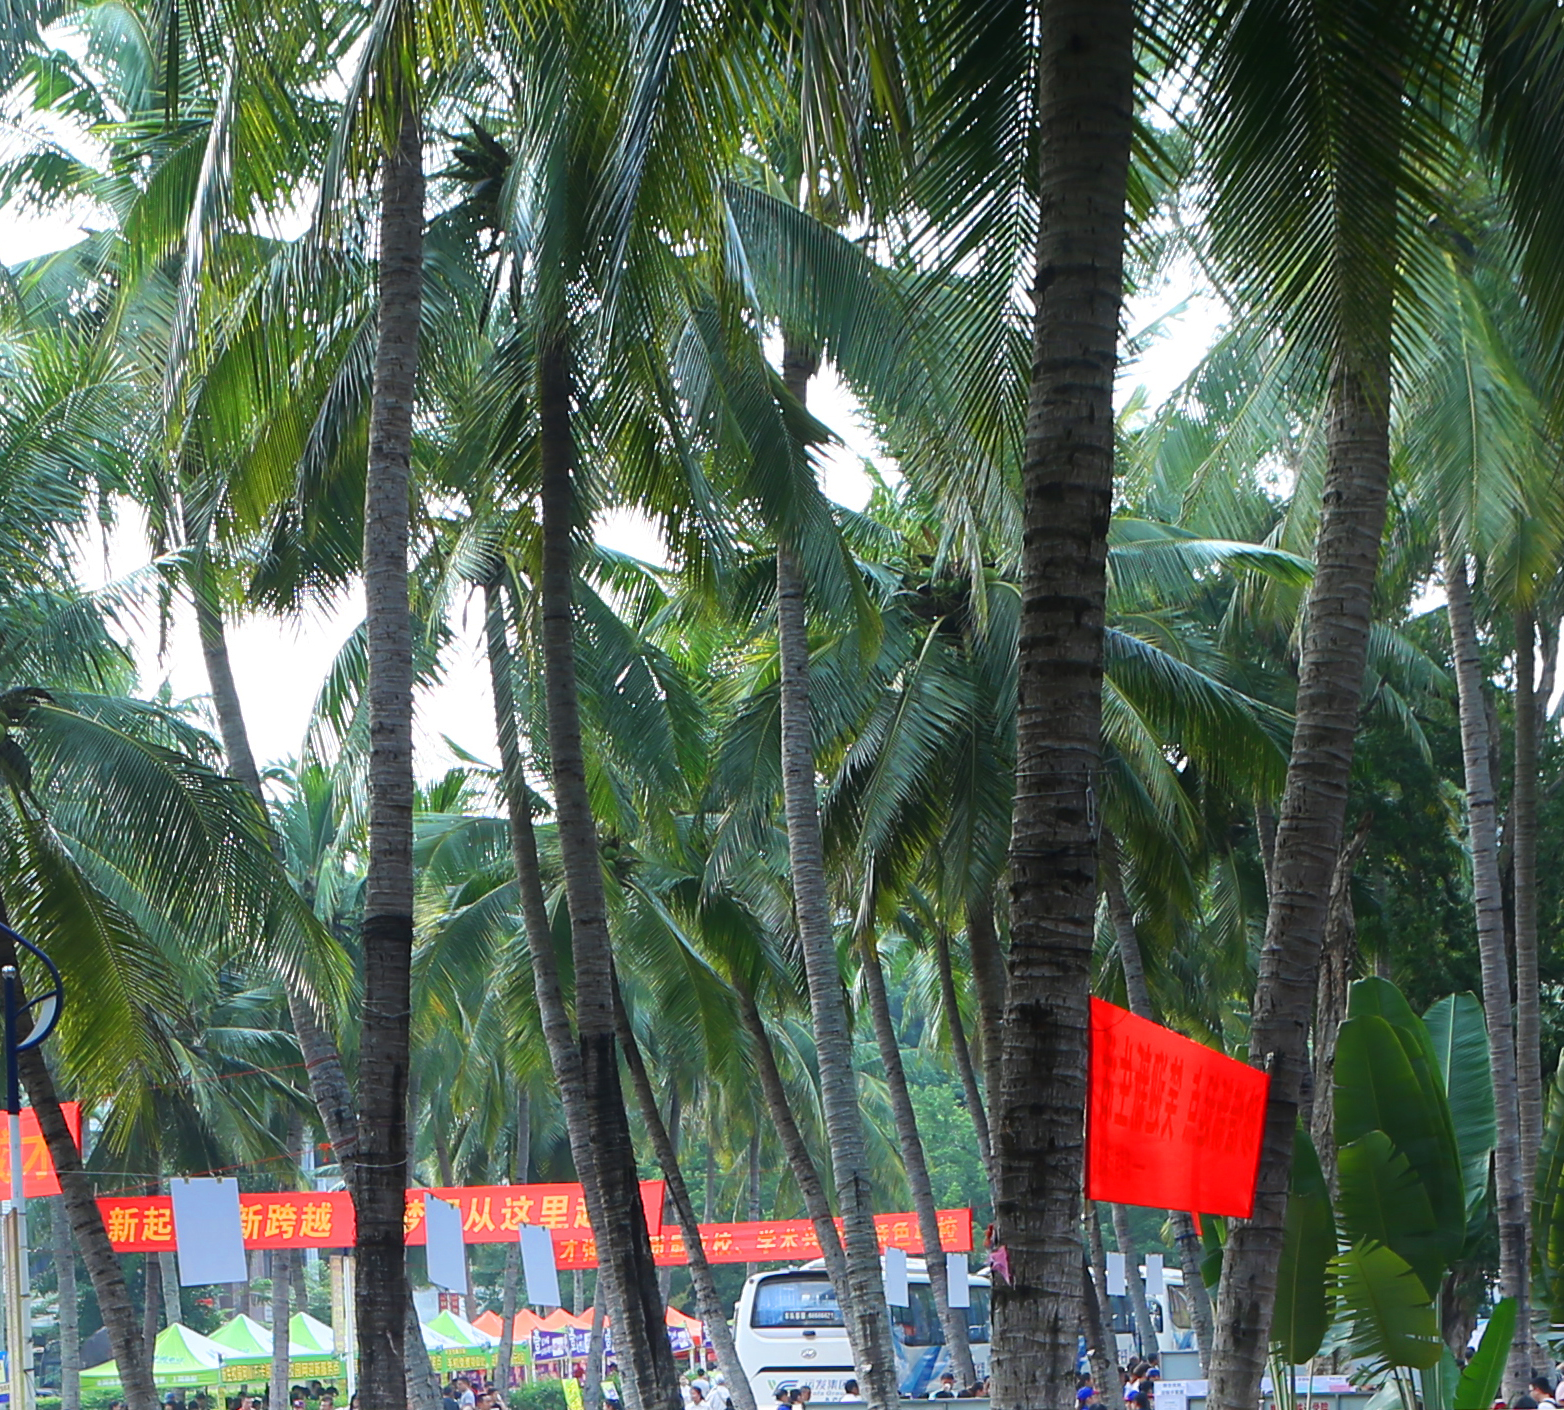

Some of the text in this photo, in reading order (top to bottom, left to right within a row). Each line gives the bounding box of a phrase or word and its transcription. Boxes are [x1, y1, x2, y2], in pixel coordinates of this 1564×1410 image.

[108, 1206, 172, 1242] 新起
[241, 1202, 333, 1240] 新跨越
